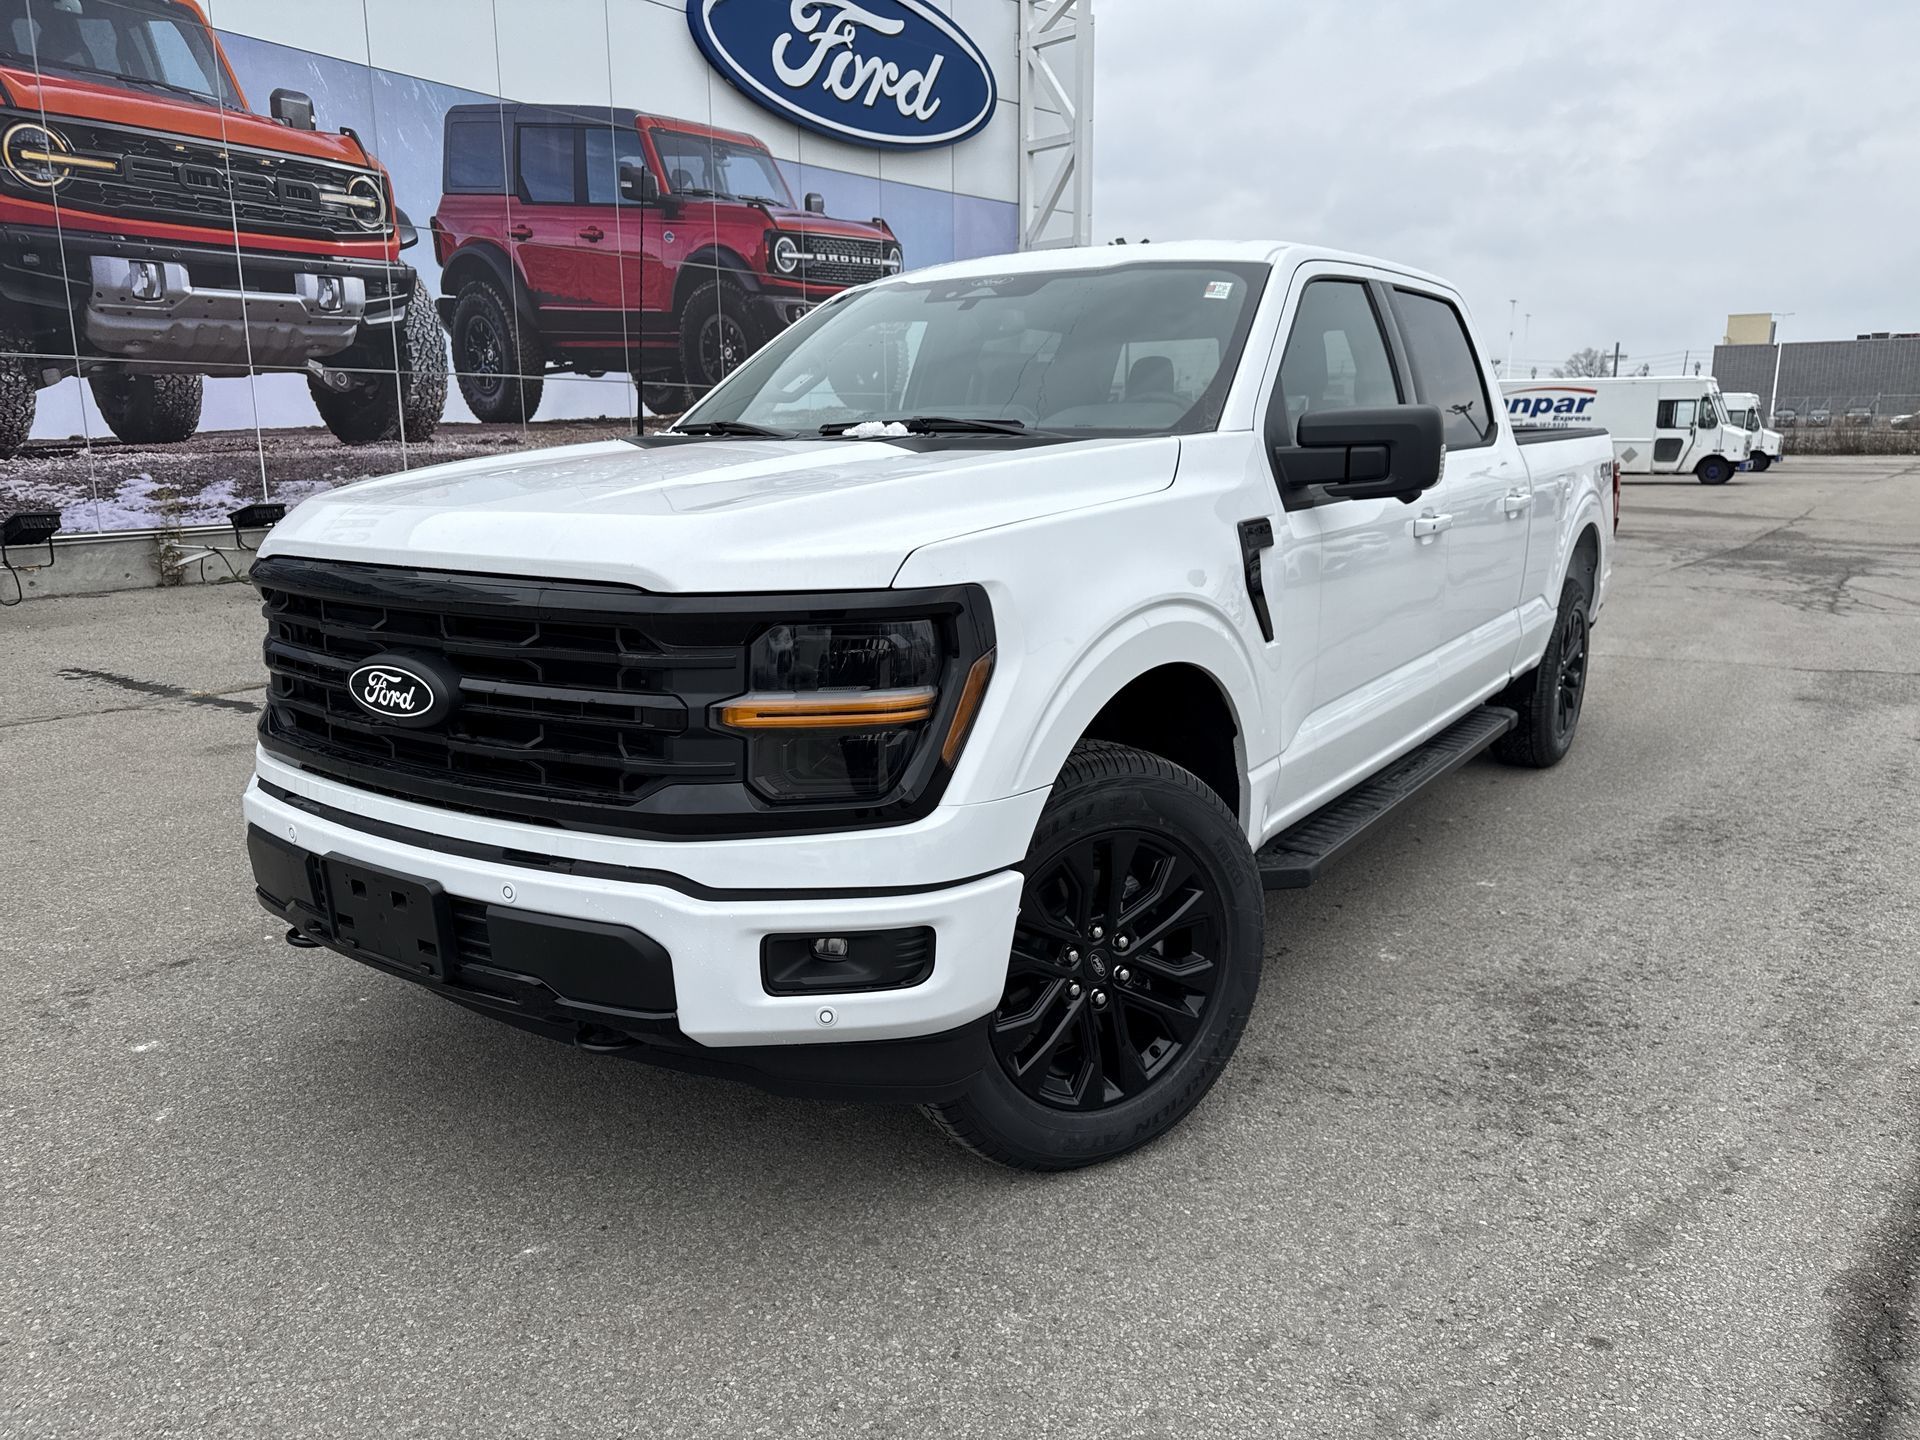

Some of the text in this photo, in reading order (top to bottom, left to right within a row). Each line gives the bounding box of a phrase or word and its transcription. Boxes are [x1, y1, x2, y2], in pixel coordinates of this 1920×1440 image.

[771, 0, 944, 121] Ford
[122, 153, 321, 208] FORD
[816, 253, 881, 265] BRONCO
[1503, 396, 1596, 418] npar
[364, 671, 416, 711] Ford
